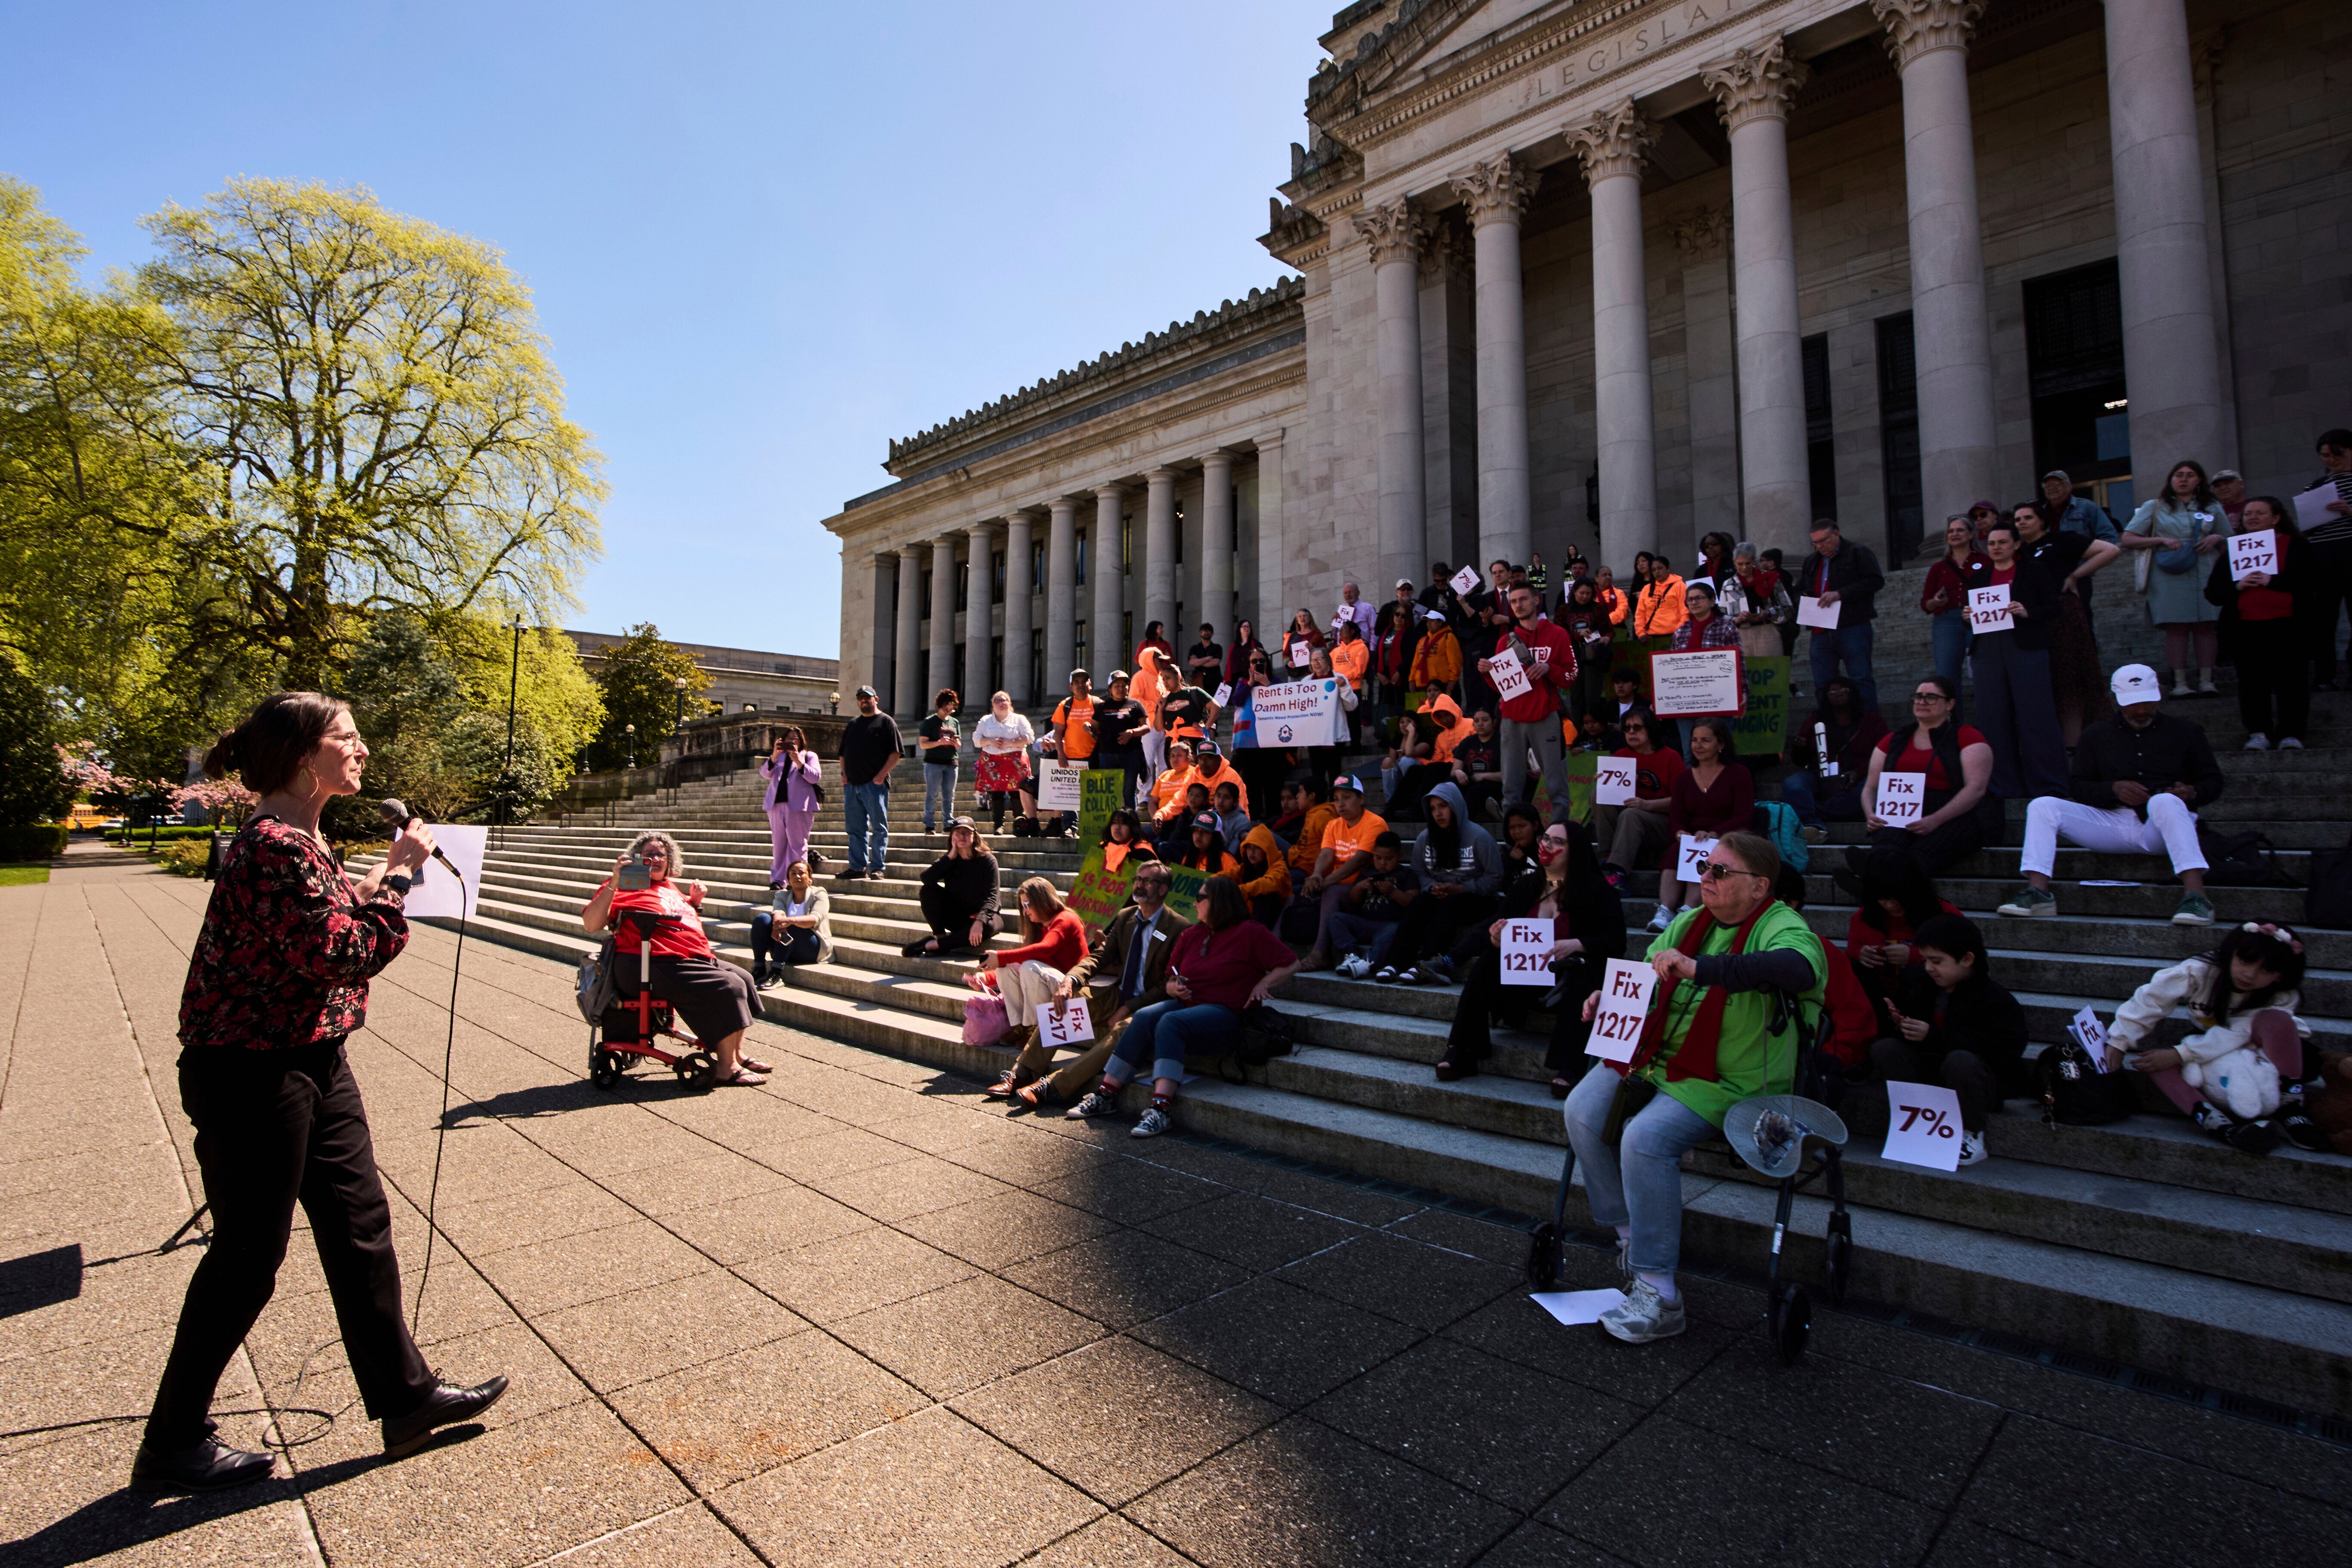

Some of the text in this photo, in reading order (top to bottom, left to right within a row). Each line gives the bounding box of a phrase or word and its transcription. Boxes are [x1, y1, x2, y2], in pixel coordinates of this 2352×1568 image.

[2238, 538, 2265, 551] Fix
[2232, 553, 2274, 571] 1217
[1458, 572, 1472, 589] 7%
[1977, 592, 2001, 605] Fix
[1972, 608, 2008, 624] 1217
[1294, 649, 1308, 657] 7%
[1492, 659, 1513, 673] Fix
[1497, 671, 1522, 691] 1217
[1746, 669, 1775, 685] TOP
[1258, 684, 1317, 699] Rent is Too
[1254, 697, 1318, 712] Damn High!
[1747, 694, 1781, 710] ENT
[1086, 776, 1115, 794] BLUE
[1602, 770, 1631, 787] 7%
[1887, 778, 1914, 793] Fix
[1085, 795, 1117, 812] COLLAR
[1879, 801, 1920, 817] 1217
[1685, 849, 1709, 863] 7
[1082, 872, 1127, 897] IS FOR
[1066, 886, 1119, 919] WORKING
[1512, 926, 1543, 943] Fix
[1504, 953, 1550, 971] 1217
[1612, 970, 1642, 1000] Fix
[1069, 1007, 1084, 1032] Fix
[1596, 1010, 1642, 1041] 1217
[2080, 1020, 2101, 1045] Fix
[1898, 1105, 1955, 1139] 7%
